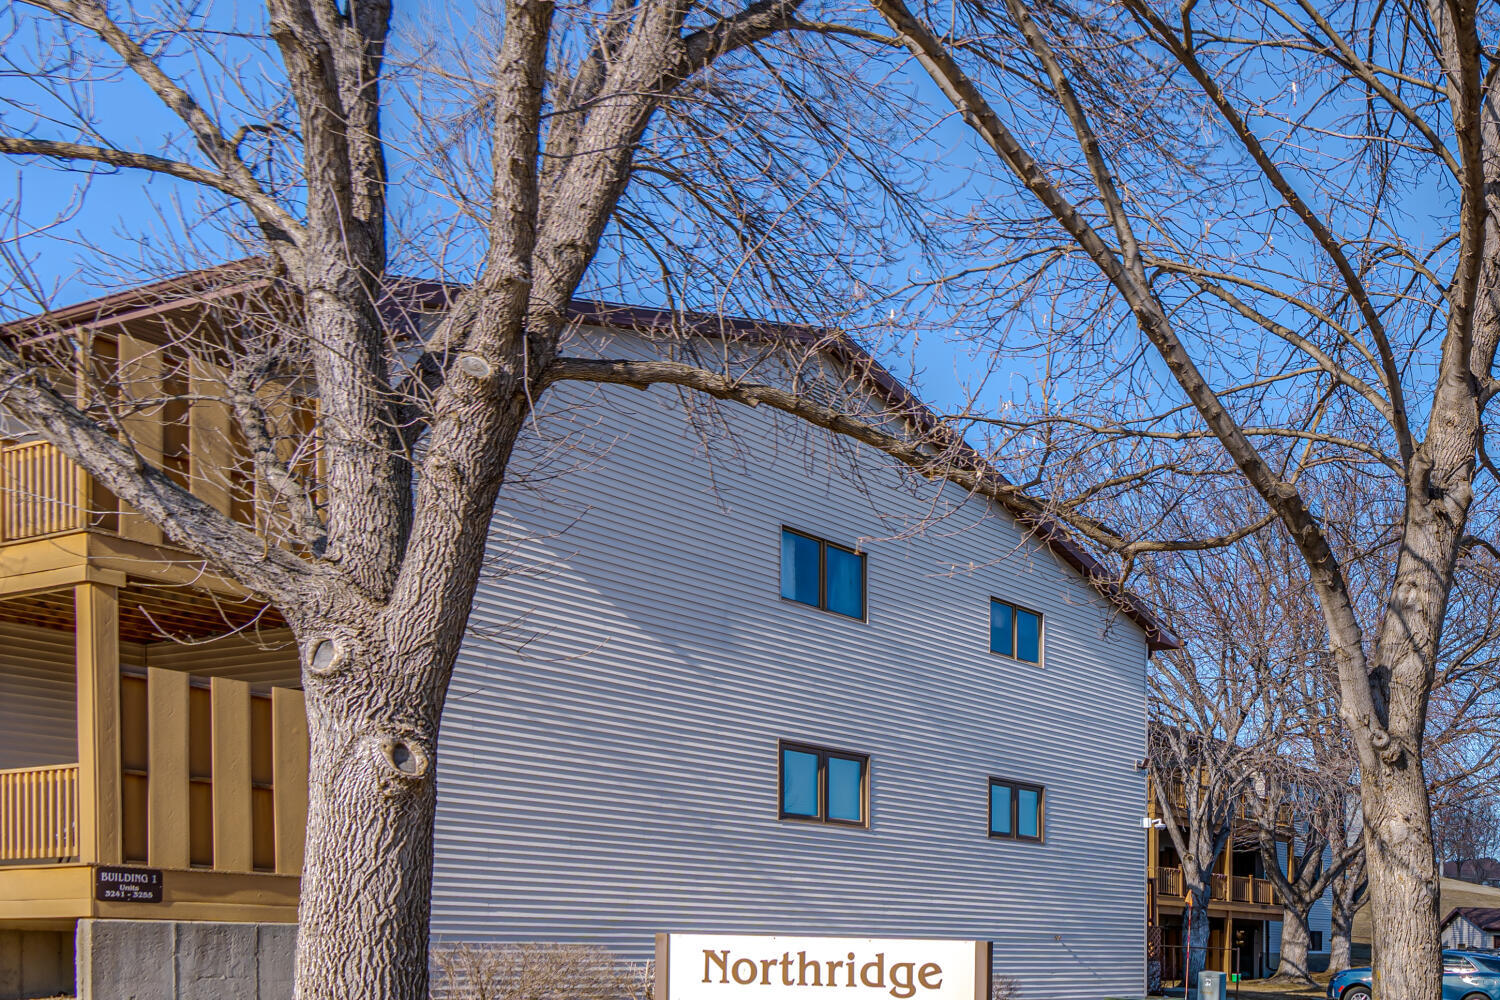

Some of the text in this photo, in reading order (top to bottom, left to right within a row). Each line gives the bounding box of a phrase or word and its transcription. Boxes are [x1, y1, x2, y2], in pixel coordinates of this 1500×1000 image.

[101, 872, 157, 884] BUILDING 1
[701, 949, 943, 999] Northridge
